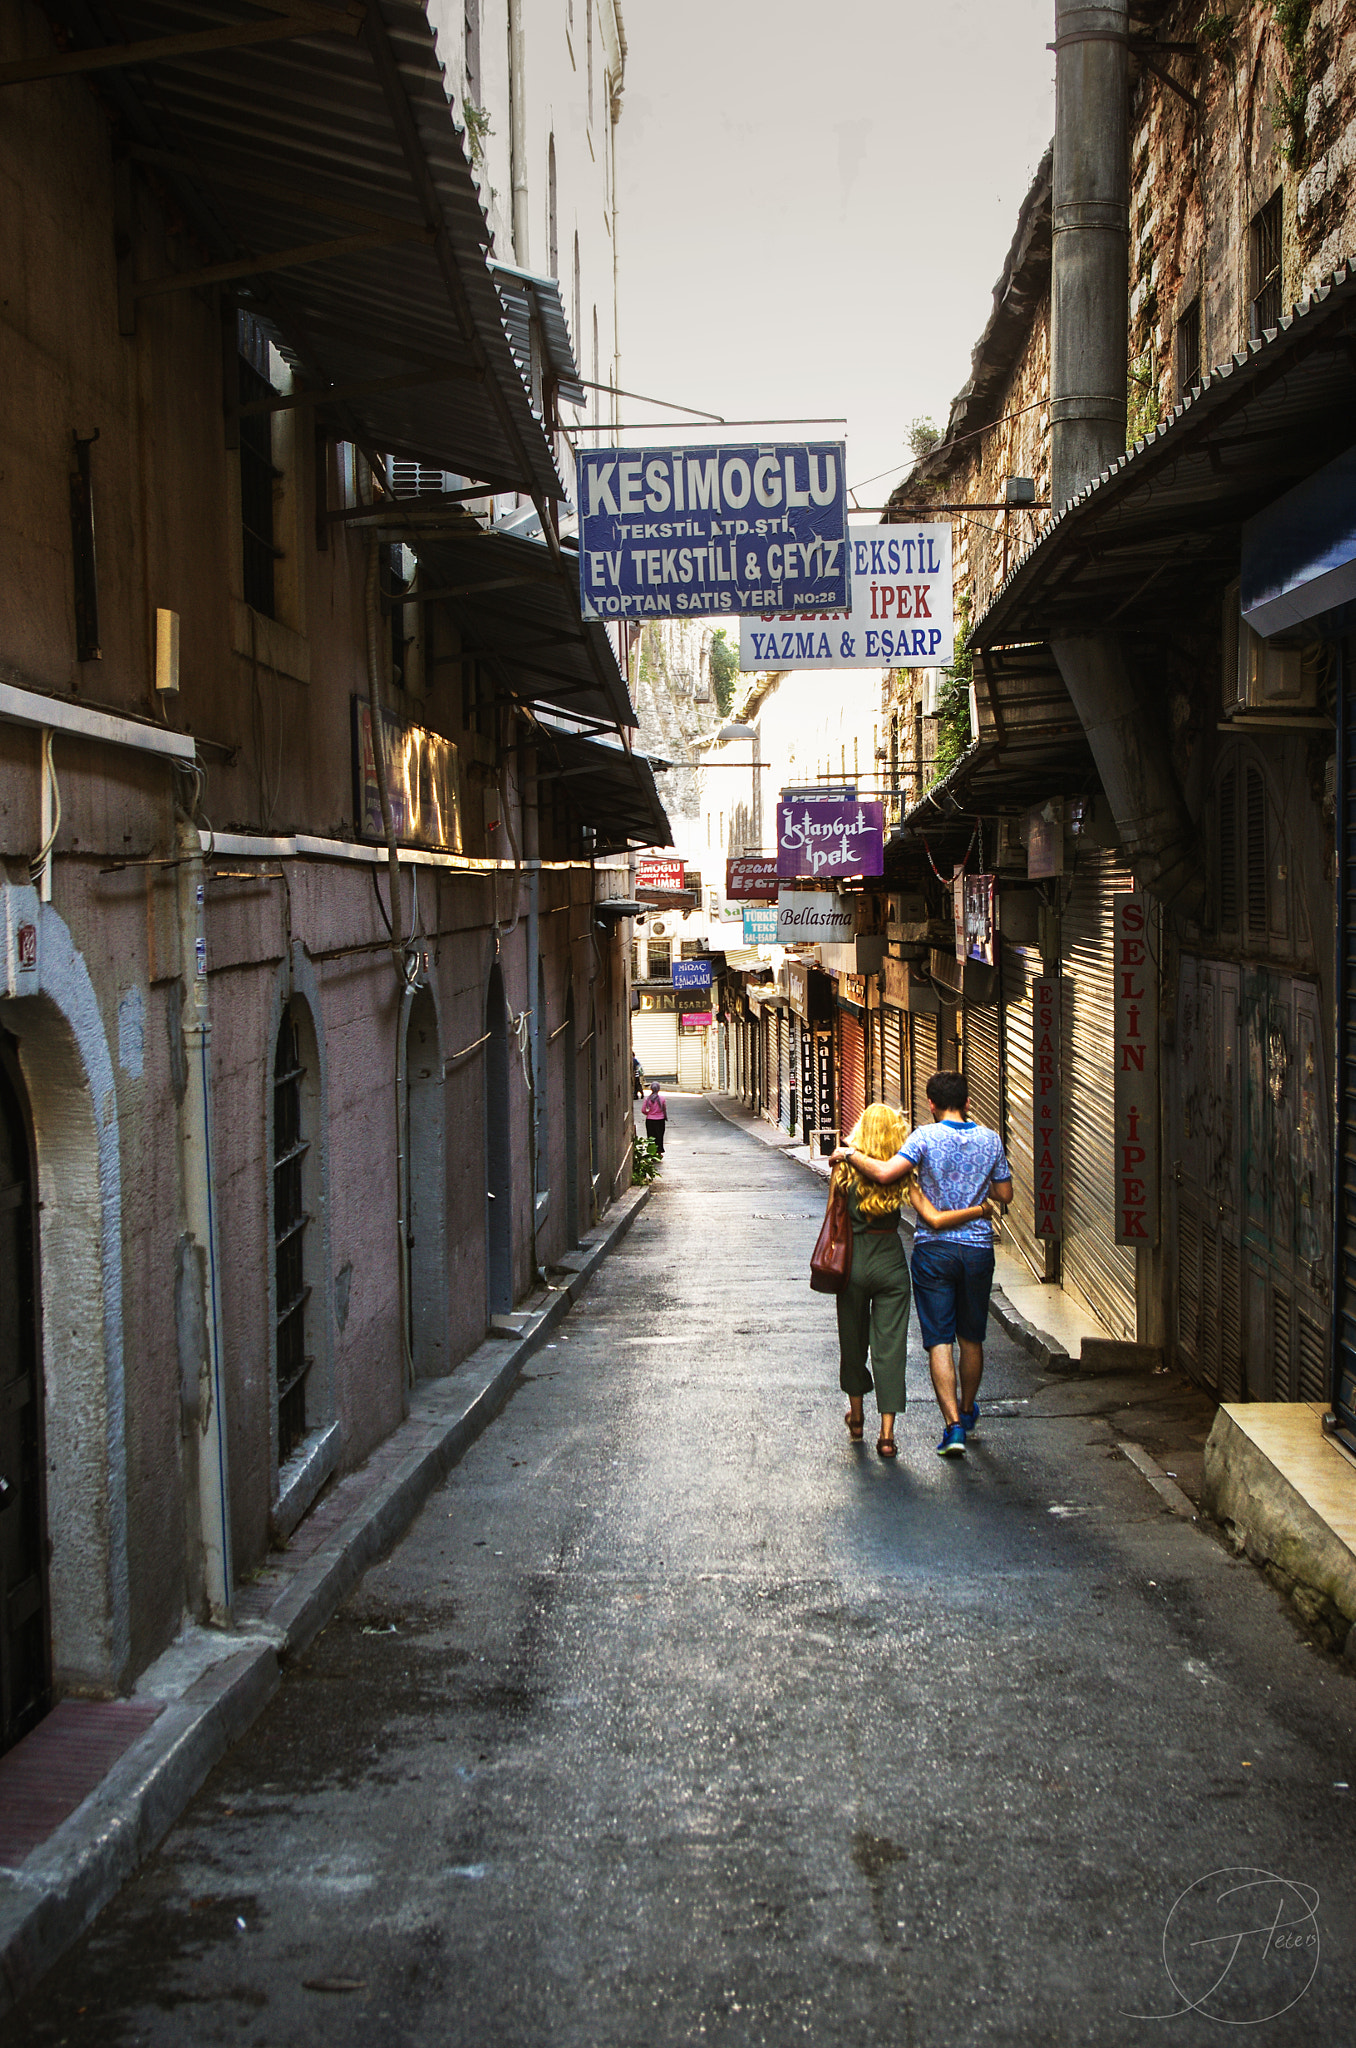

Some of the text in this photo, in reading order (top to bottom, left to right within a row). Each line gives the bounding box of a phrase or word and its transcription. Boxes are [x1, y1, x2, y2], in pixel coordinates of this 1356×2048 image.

[587, 447, 837, 516] KESİMOĞLU
[618, 518, 706, 540] TEKSTİL
[590, 538, 840, 587] EV TEKSTİLİ & ÇEYİZ
[850, 532, 941, 576] EKSTİL
[593, 585, 836, 614] TOPTAN SATIŞ YERİ NO:28
[869, 581, 933, 620] İPEK
[750, 628, 942, 663] YAZMA & EŞARP
[751, 922, 778, 932] TEKS
[780, 906, 852, 926] Bellasima
[1120, 903, 1149, 1239] SELİN İPEK
[1037, 985, 1057, 1235] EŞARP & YAZMA
